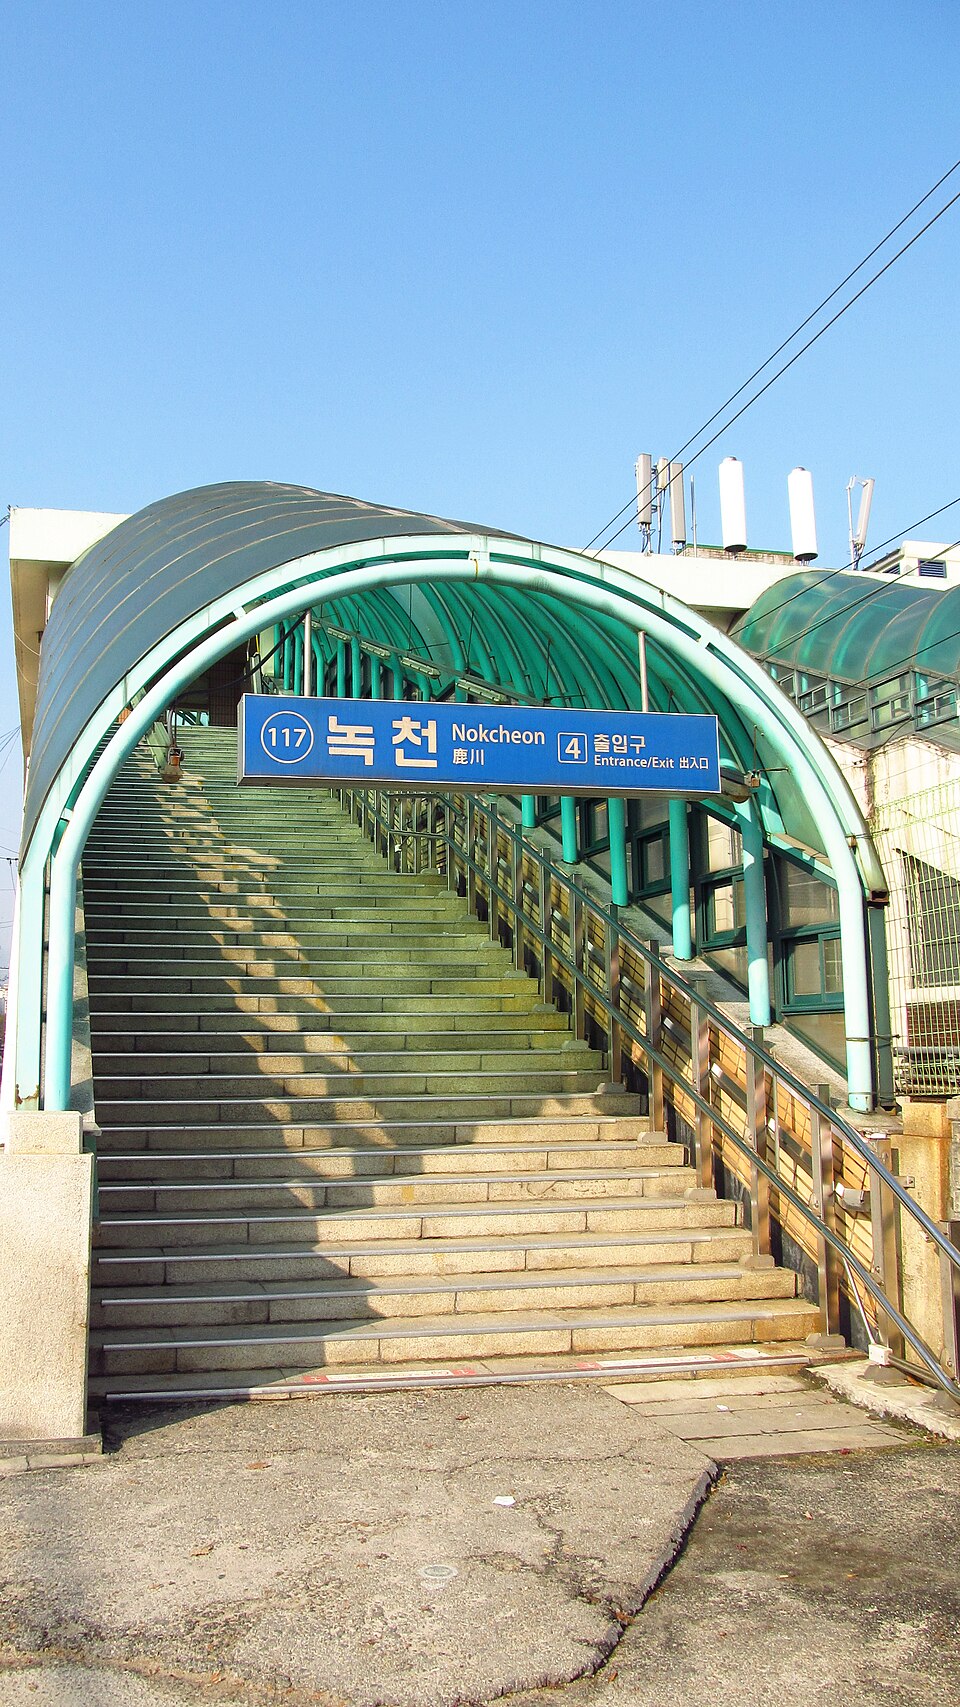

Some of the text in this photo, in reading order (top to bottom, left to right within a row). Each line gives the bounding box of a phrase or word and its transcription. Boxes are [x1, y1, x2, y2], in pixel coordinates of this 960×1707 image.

[267, 727, 307, 748] 117
[326, 715, 438, 768] 녹천
[452, 723, 546, 745] Nokcheon
[593, 733, 646, 754] 출입구
[452, 748, 485, 766] 鹿川
[564, 737, 581, 760] 4
[594, 755, 709, 770] Entrance/Exit 出入口
